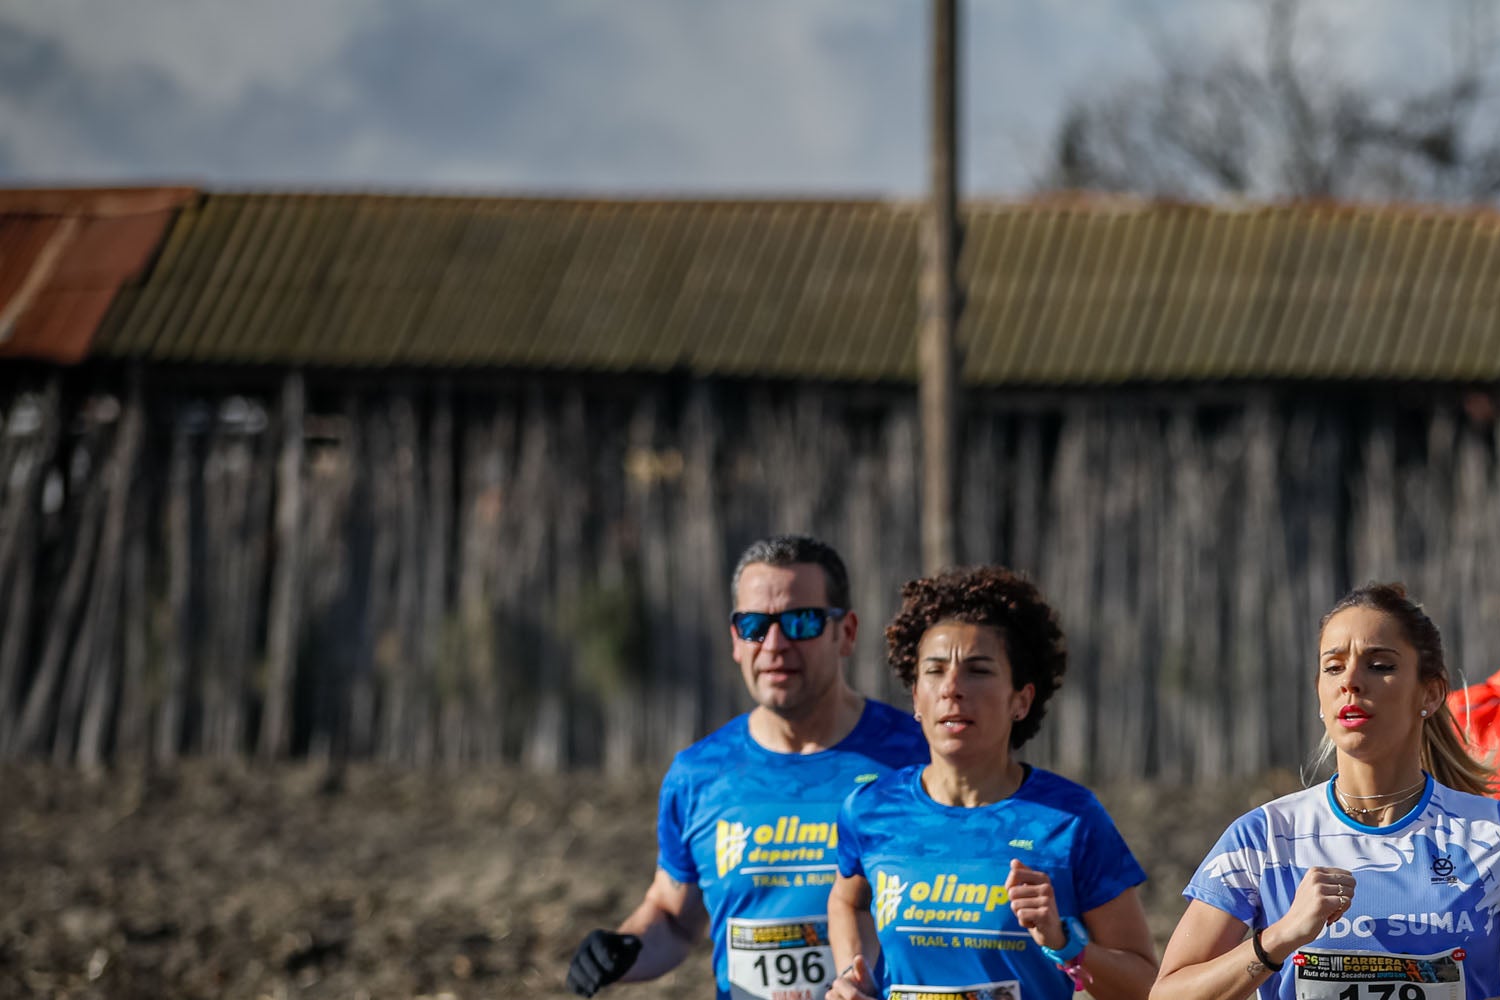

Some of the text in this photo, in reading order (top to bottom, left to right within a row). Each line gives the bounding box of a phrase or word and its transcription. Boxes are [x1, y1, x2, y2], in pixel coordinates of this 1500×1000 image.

[748, 847, 824, 865] deportes
[752, 874, 791, 888] TRAIL
[793, 874, 804, 887] &
[903, 905, 981, 924] deportes
[1387, 910, 1475, 937] SUMA
[909, 935, 1027, 951] TRAIL & RUNNING
[754, 951, 825, 987] 196
[1330, 956, 1343, 971] VII
[1343, 956, 1404, 965] CARRERA
[1343, 964, 1403, 972] POPULAR
[1303, 969, 1319, 977] Ruta
